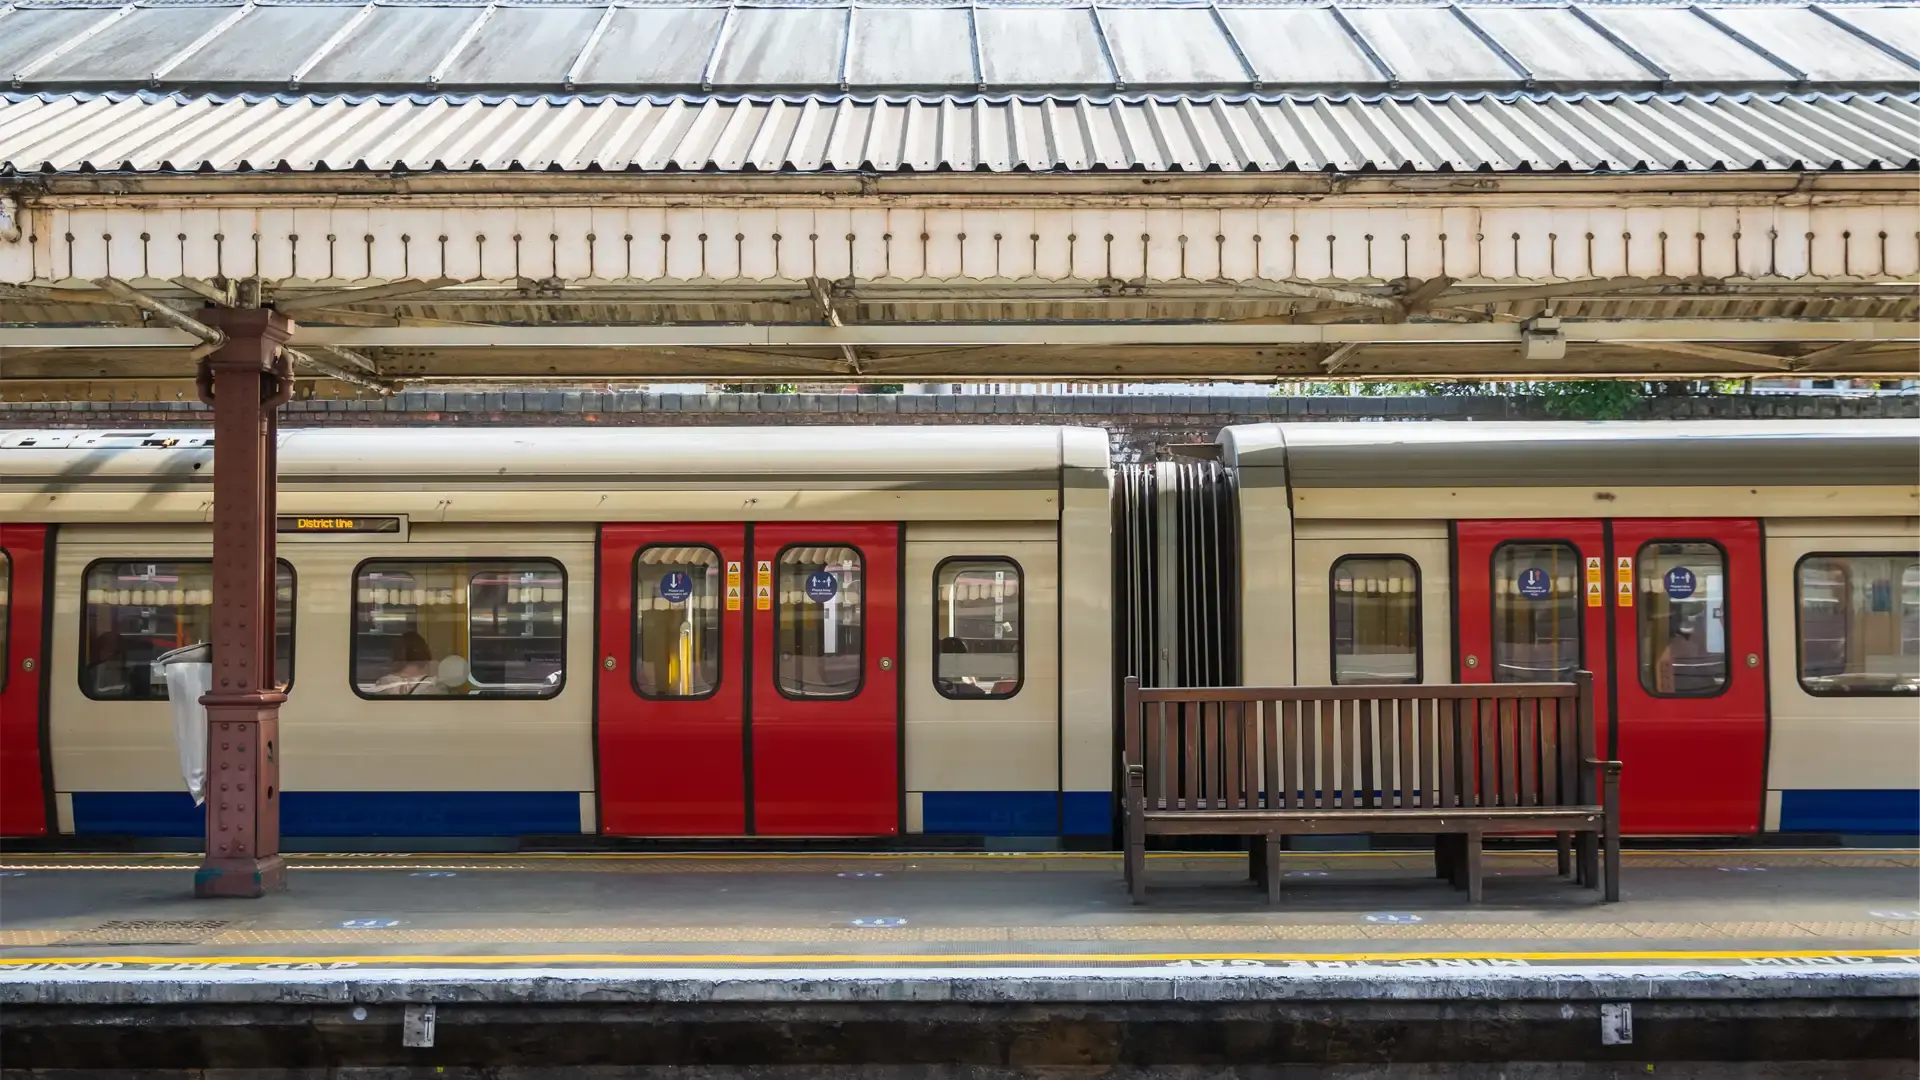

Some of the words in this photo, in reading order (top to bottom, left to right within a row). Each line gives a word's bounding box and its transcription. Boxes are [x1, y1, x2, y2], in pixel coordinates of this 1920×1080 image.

[297, 518, 333, 528] District
[335, 518, 354, 528] line
[147, 963, 241, 971] THE
[256, 961, 360, 970] GAP
[1740, 956, 1874, 966] MIND
